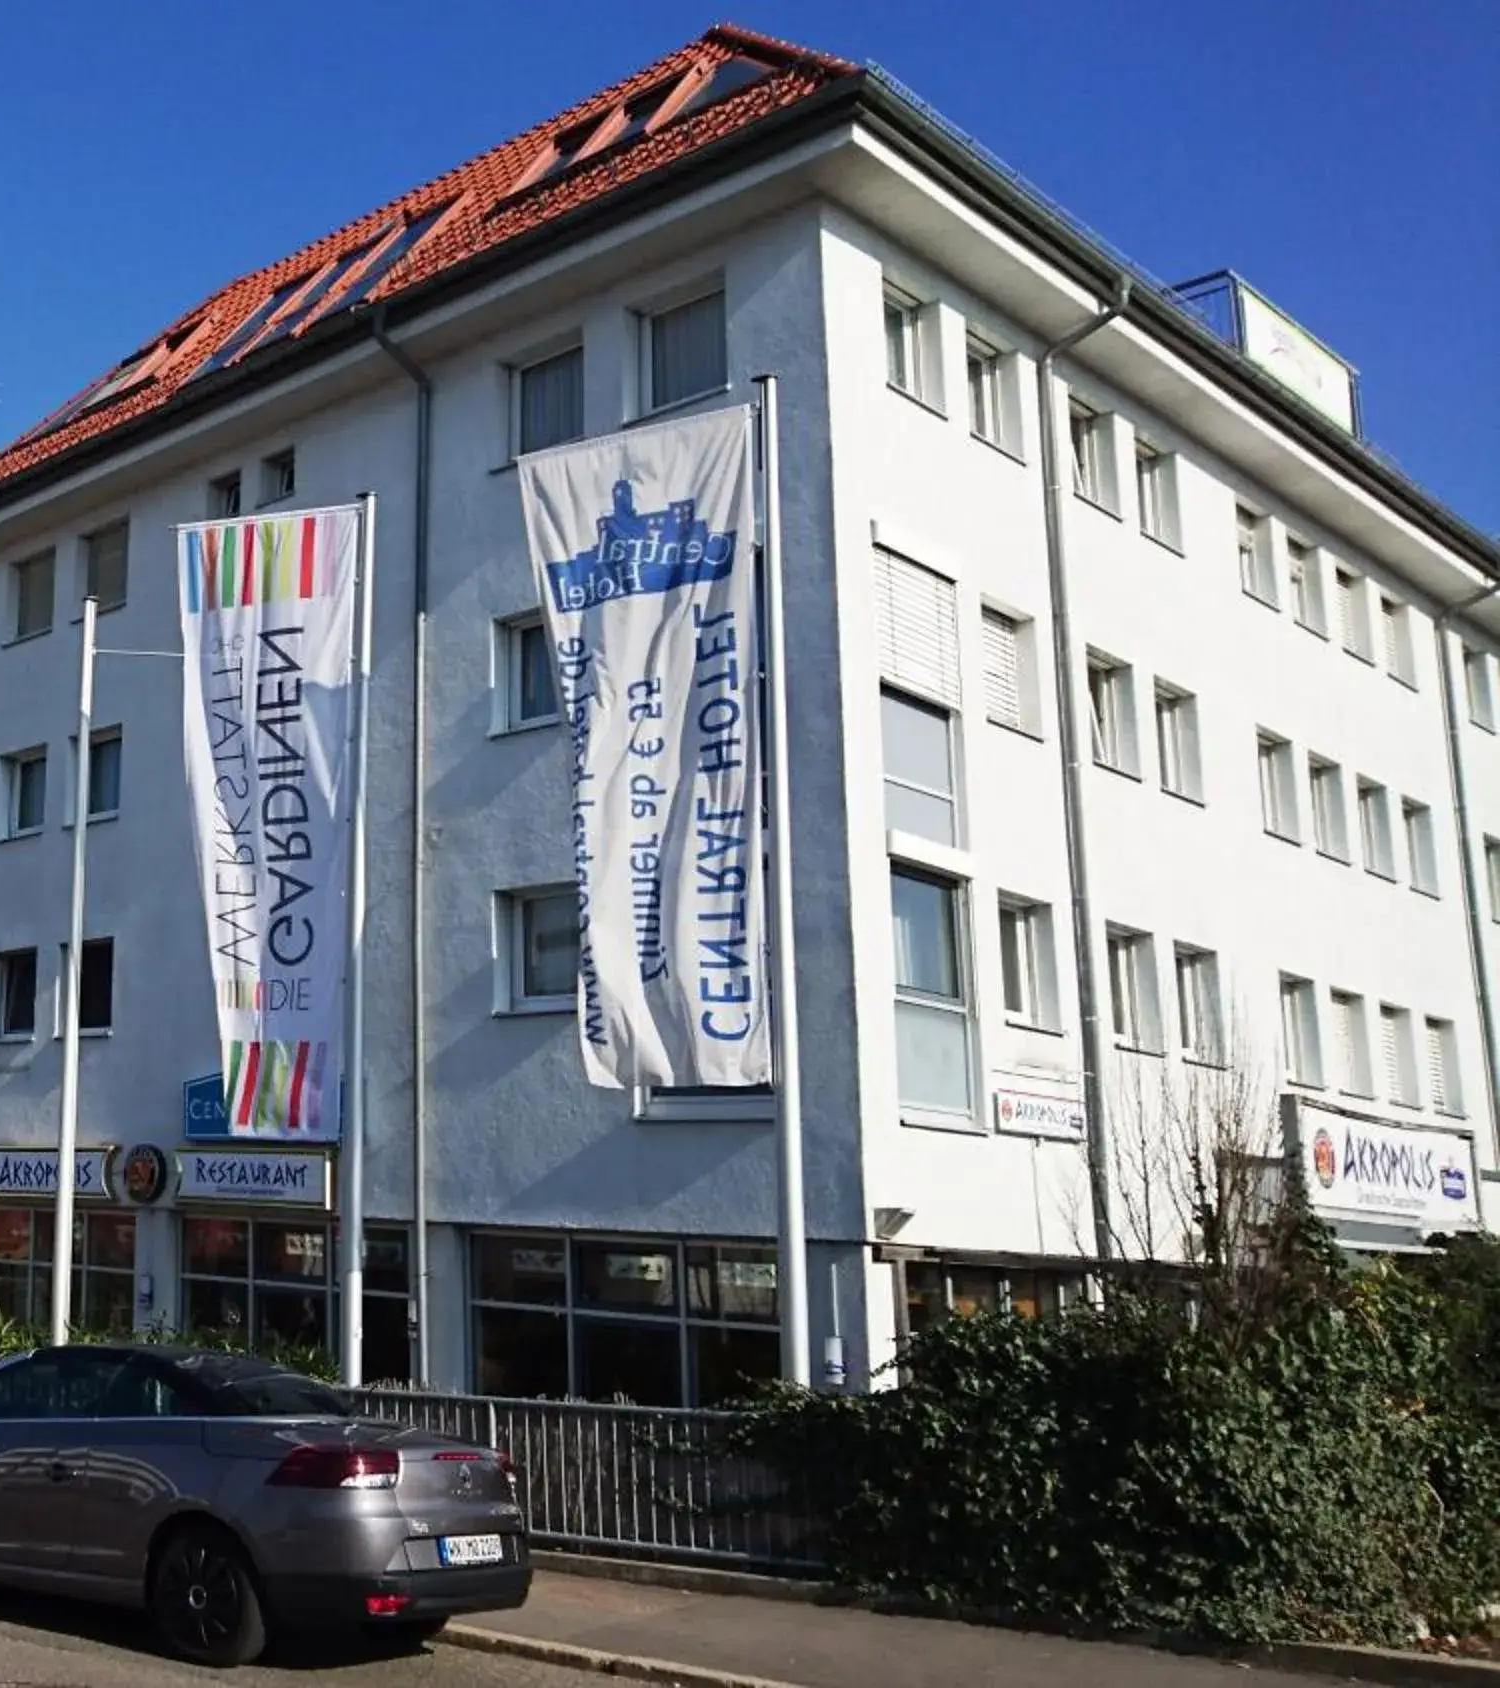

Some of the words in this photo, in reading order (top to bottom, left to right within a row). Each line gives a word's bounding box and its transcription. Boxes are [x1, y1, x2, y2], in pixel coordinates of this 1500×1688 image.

[268, 978, 311, 1011] DIE
[194, 1156, 308, 1188] RESTAURANT
[1342, 1126, 1436, 1193] AKROPOLIS
